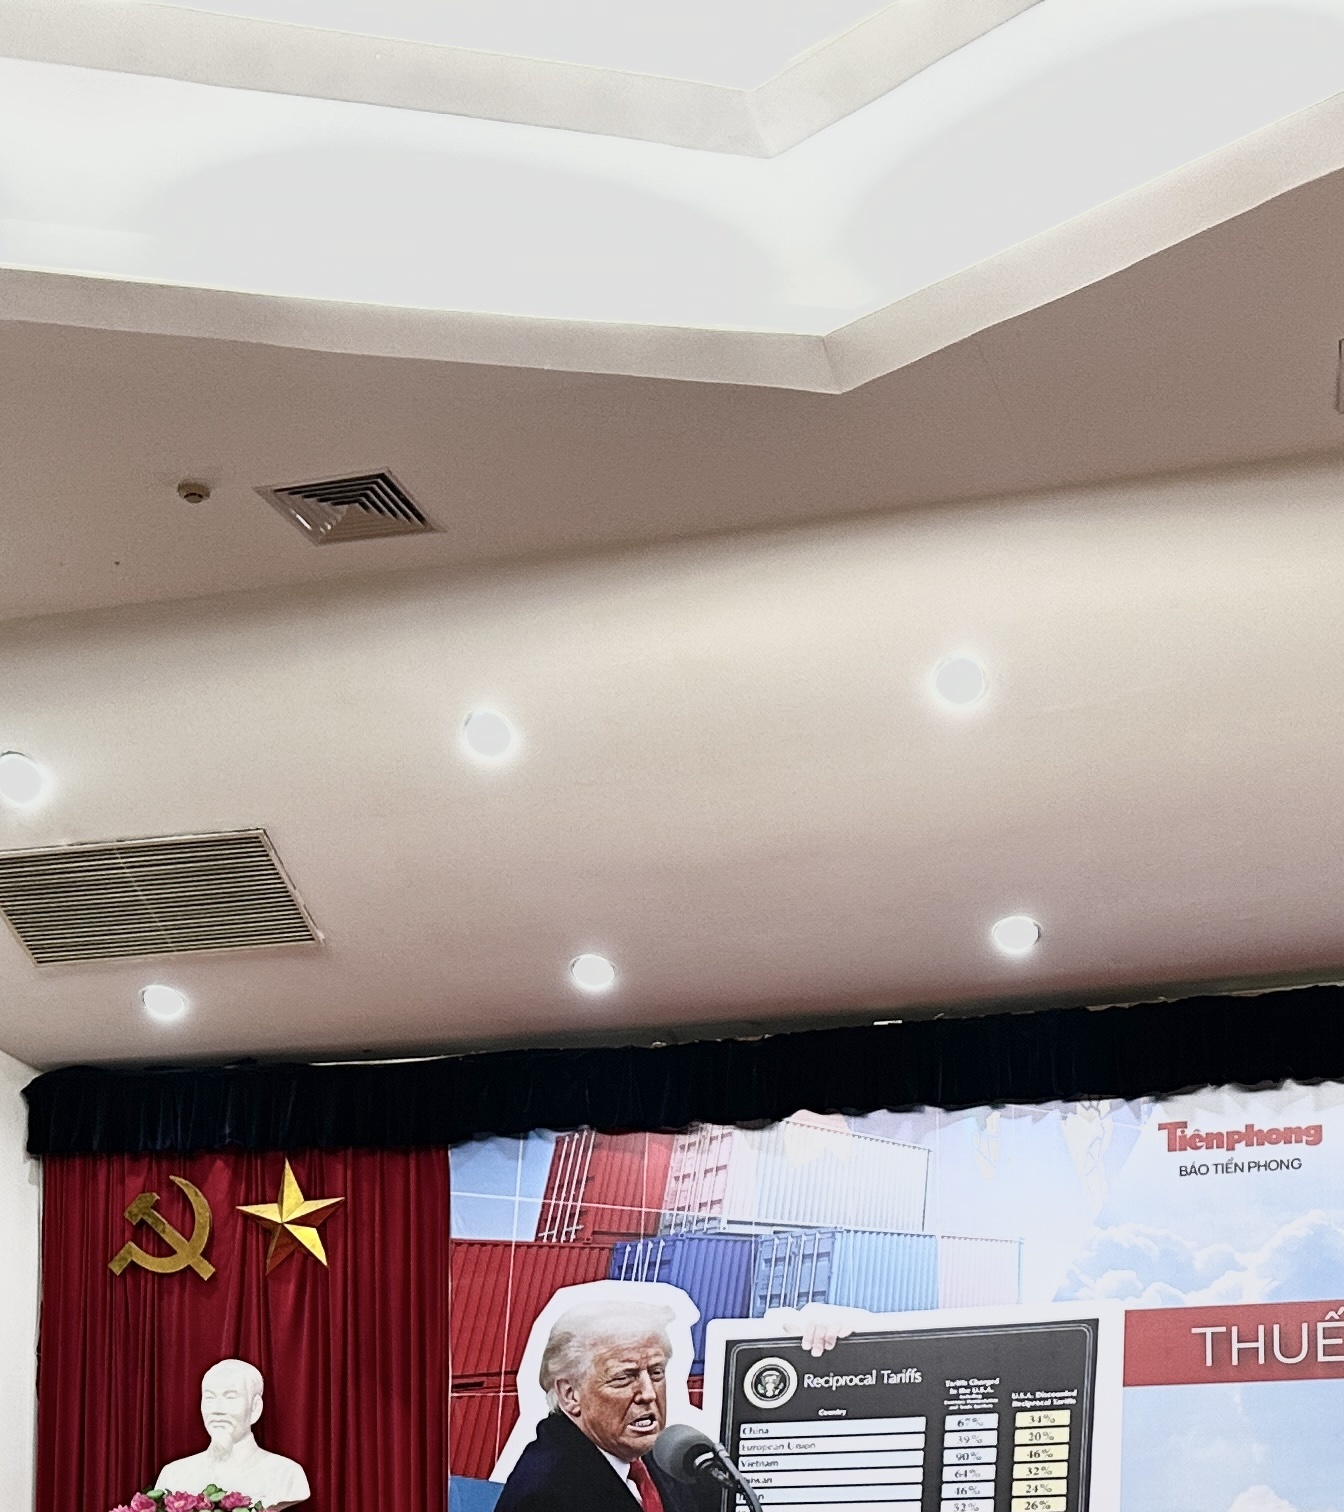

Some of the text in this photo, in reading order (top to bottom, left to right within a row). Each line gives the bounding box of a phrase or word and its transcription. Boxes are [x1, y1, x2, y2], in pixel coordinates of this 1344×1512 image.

[1179, 1161, 1209, 1176] BÁO
[1247, 1158, 1302, 1174] PHONG
[803, 1367, 923, 1391] Reciprocal Tariffs
[1024, 1500, 1051, 1510] 26%
